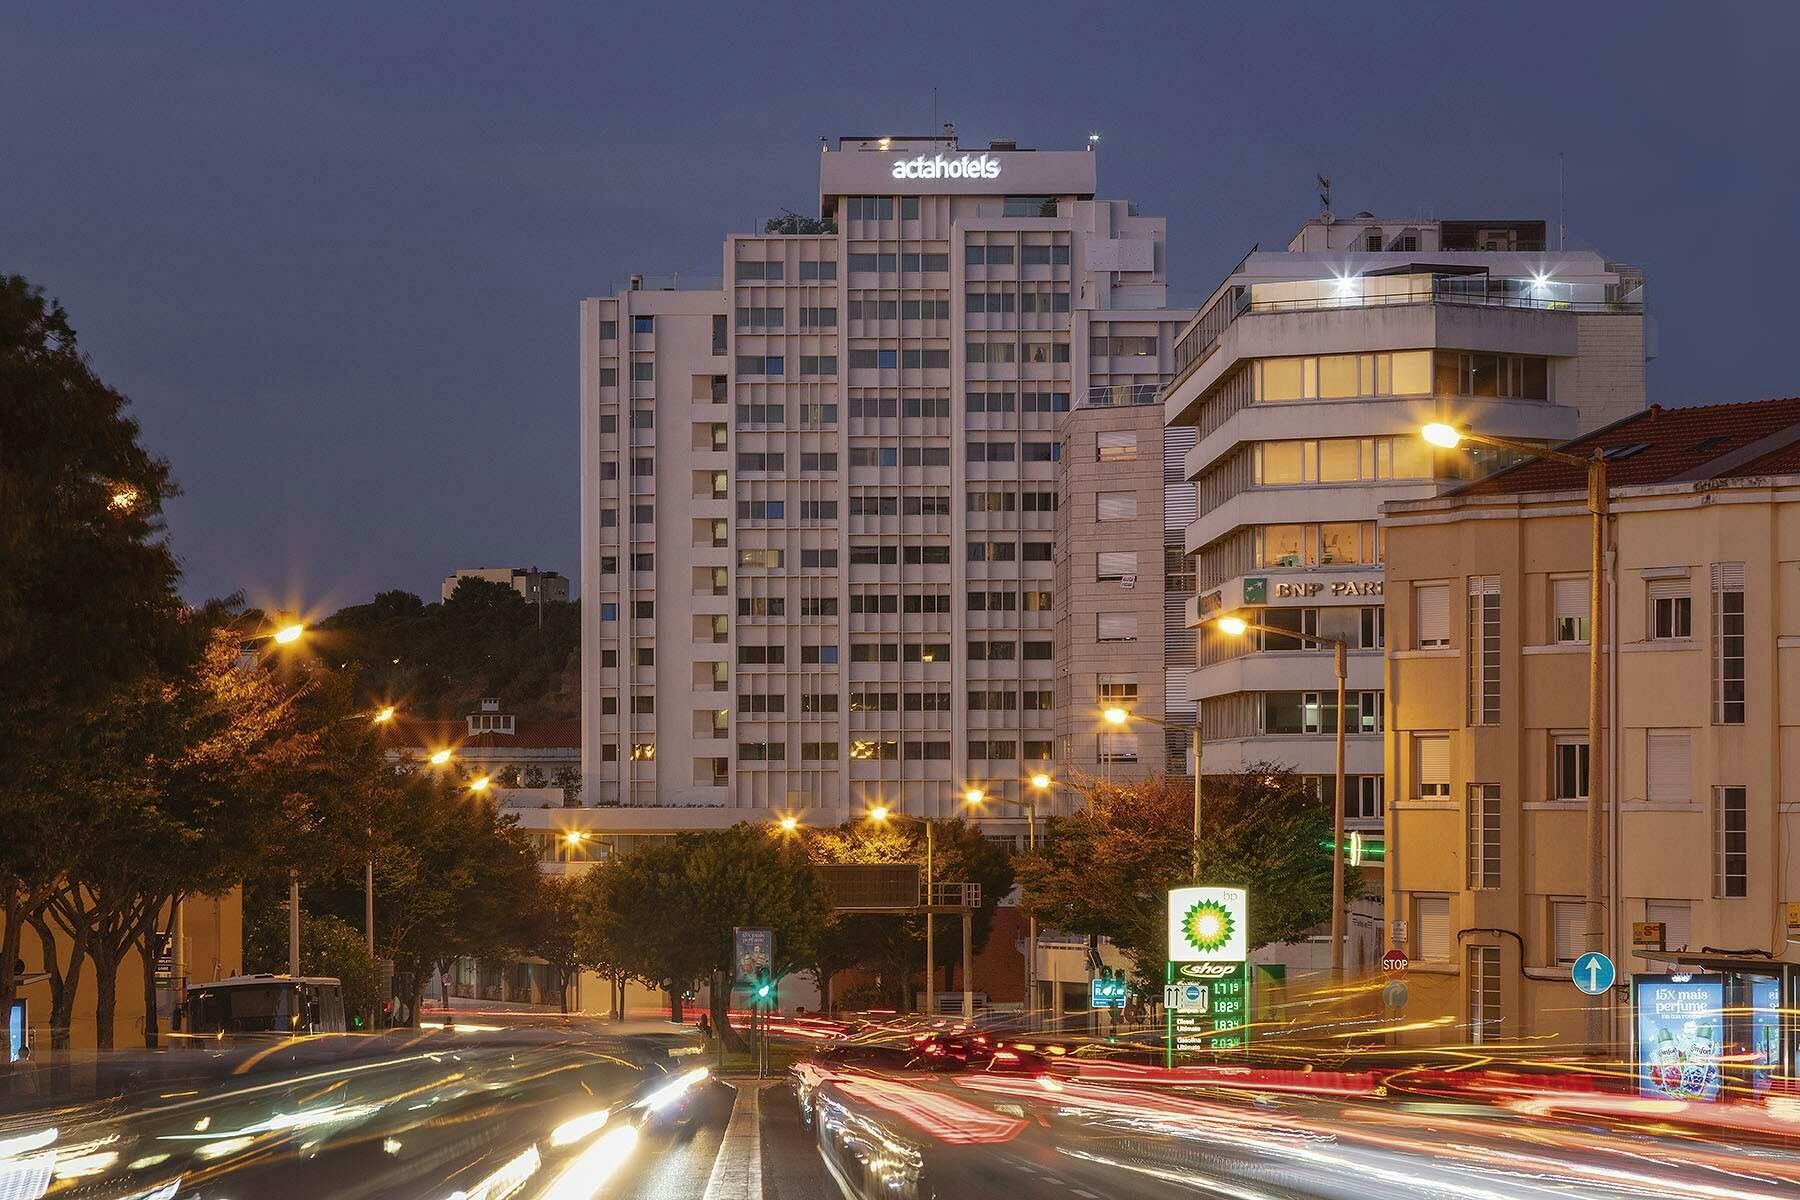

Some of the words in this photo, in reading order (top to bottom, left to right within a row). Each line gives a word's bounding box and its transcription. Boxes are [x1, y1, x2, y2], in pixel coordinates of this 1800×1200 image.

[892, 153, 1001, 179] actahotels
[1276, 583, 1323, 598] BNP
[1223, 890, 1238, 902] bp
[1190, 962, 1236, 978] shop
[1383, 959, 1408, 970] STOP
[1678, 987, 1708, 1001] mais
[1655, 1000, 1708, 1015] perfume
[1176, 1025, 1201, 1033] Ultimate
